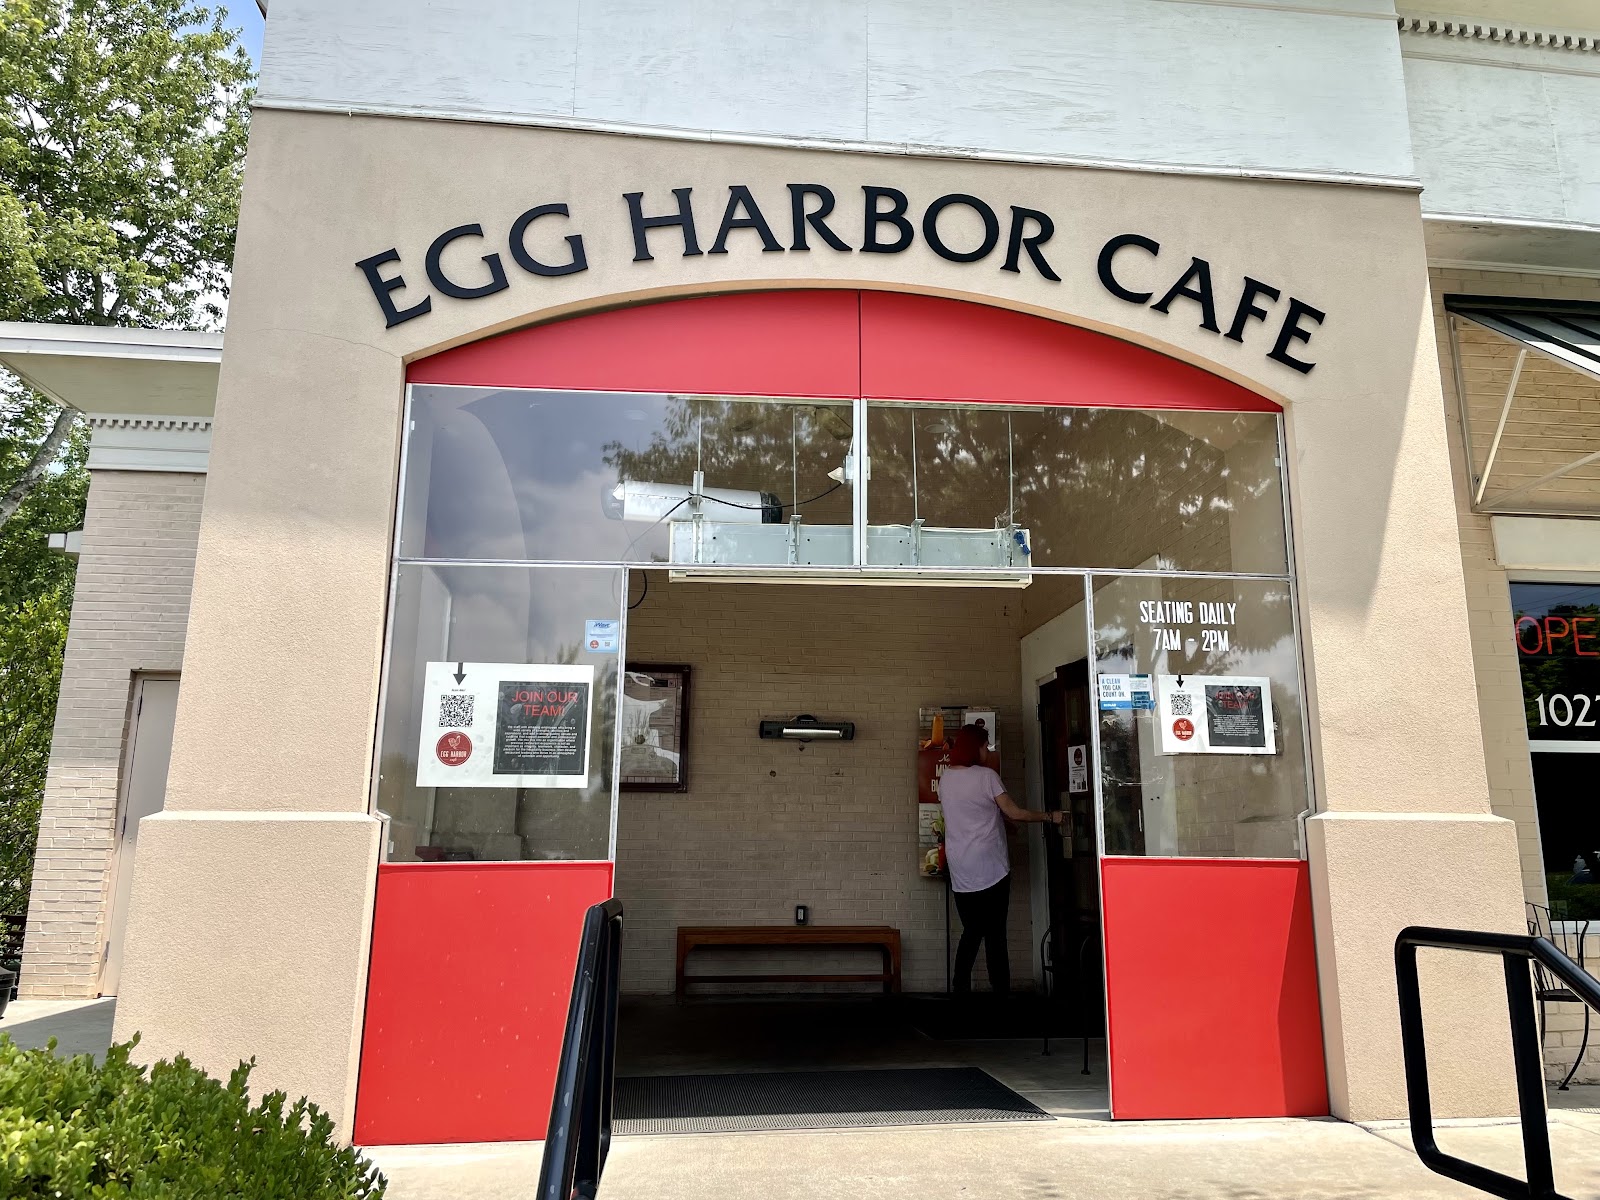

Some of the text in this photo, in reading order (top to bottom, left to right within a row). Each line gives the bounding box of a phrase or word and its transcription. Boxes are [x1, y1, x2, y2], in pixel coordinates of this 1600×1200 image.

[355, 184, 1325, 373] EGG HARBOR CAFE
[1139, 600, 1237, 625] SEATING DAILY
[1152, 628, 1181, 651] 7AM
[1201, 629, 1230, 652] 2PM
[512, 691, 578, 703] JOIN OUR
[524, 704, 565, 717] TEAM!
[1535, 693, 1600, 727] 102
[440, 750, 467, 758] EGG HARBOR
